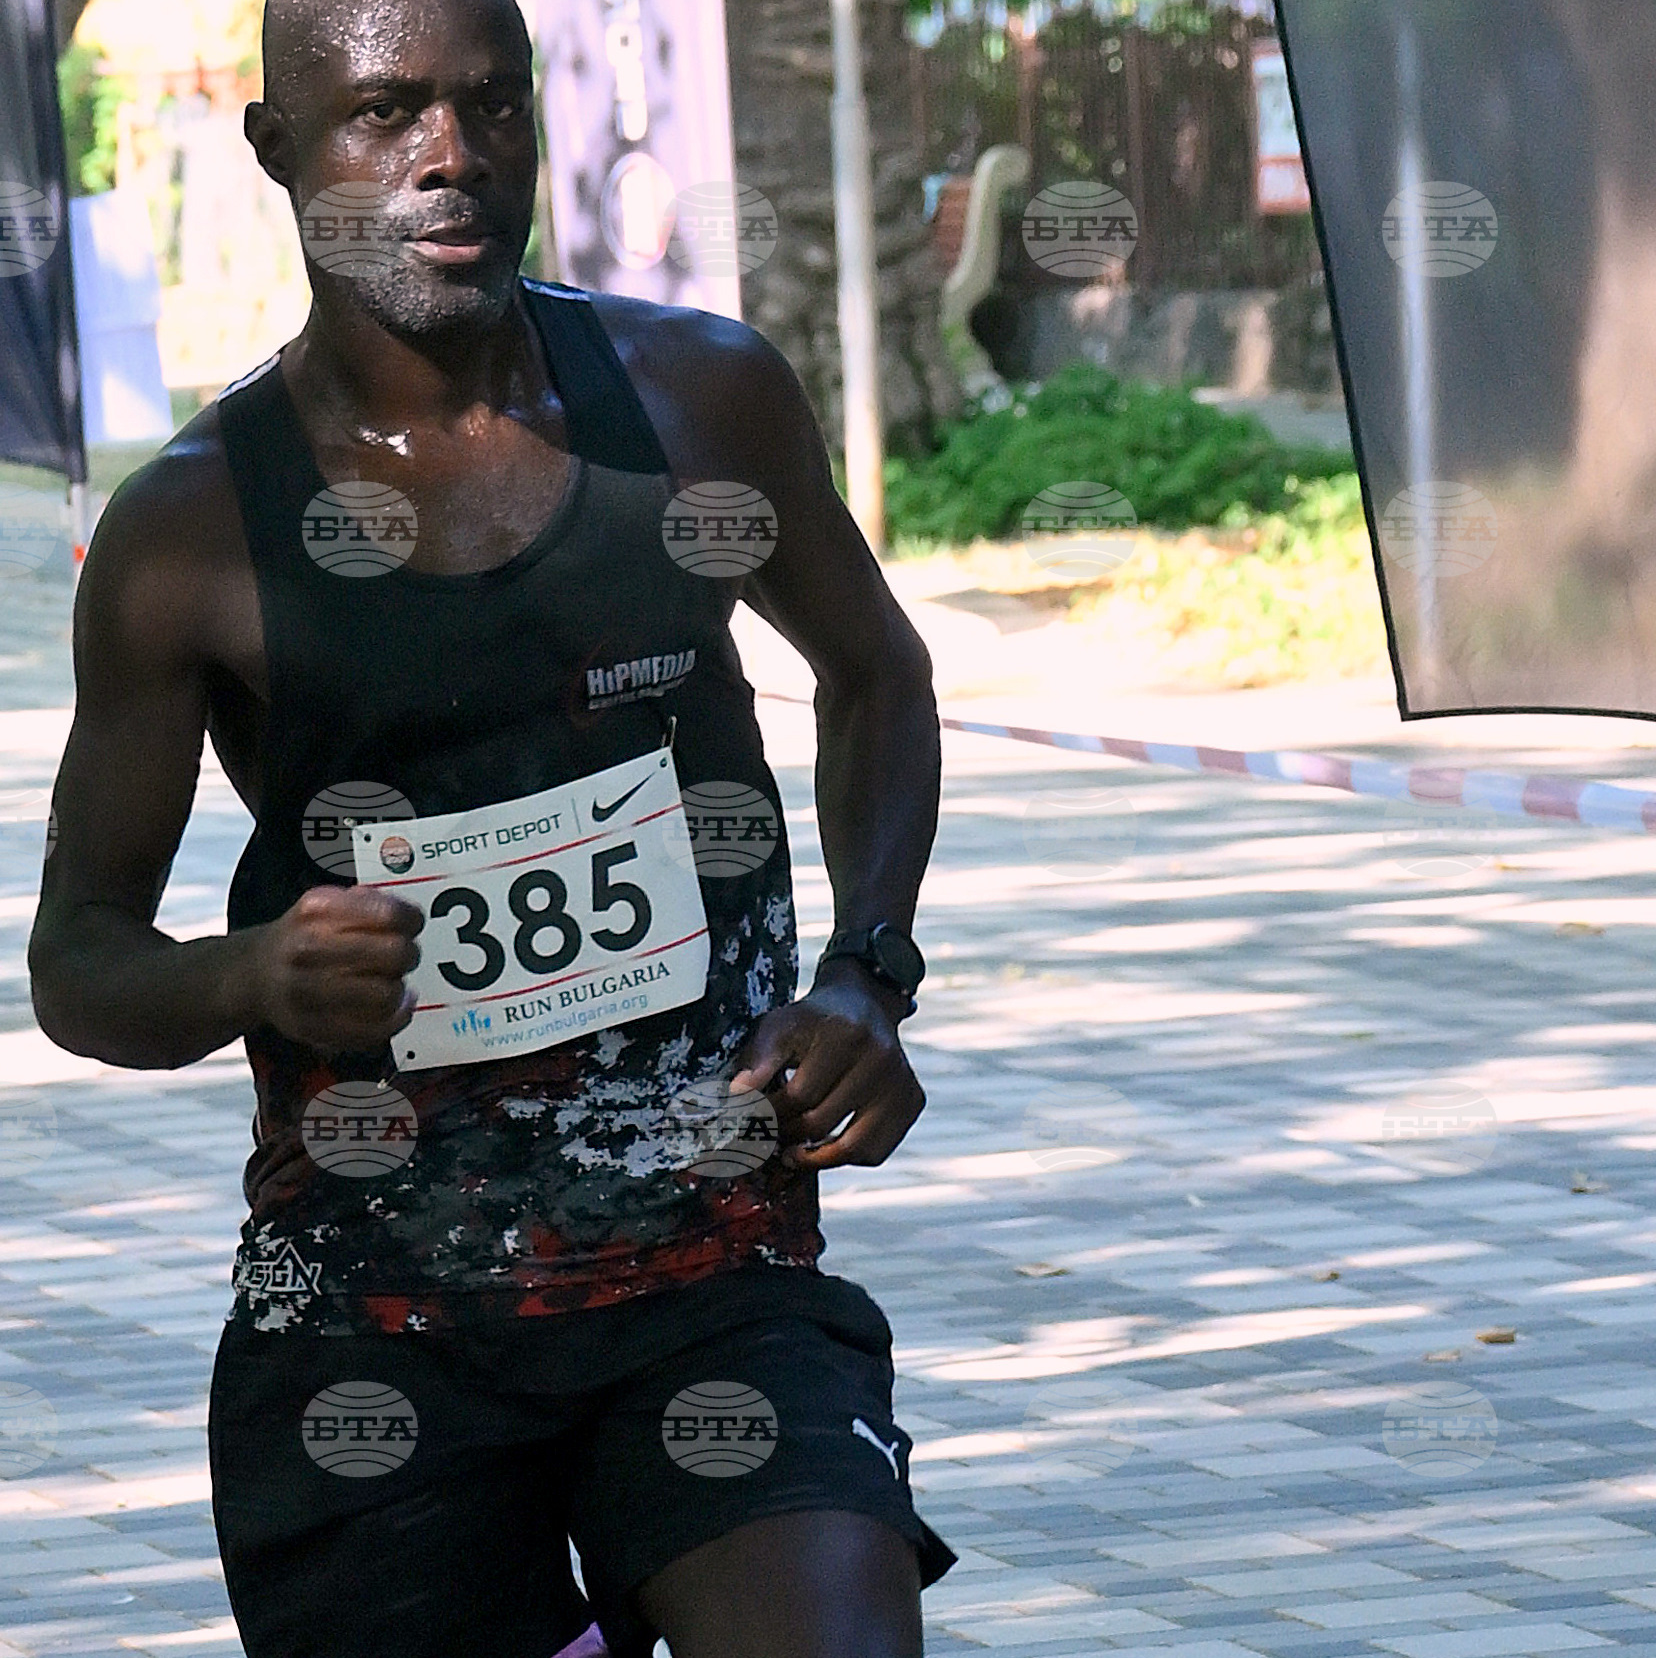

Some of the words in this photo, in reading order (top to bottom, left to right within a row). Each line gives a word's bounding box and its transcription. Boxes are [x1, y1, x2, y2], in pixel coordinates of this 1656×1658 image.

[422, 832, 489, 860] SPORT
[496, 813, 562, 845] DEPOT
[430, 840, 652, 992] 385
[484, 993, 649, 1047] www.runbulgaria.org
[504, 996, 552, 1023] RUN
[560, 961, 671, 1009] BULGARIA
